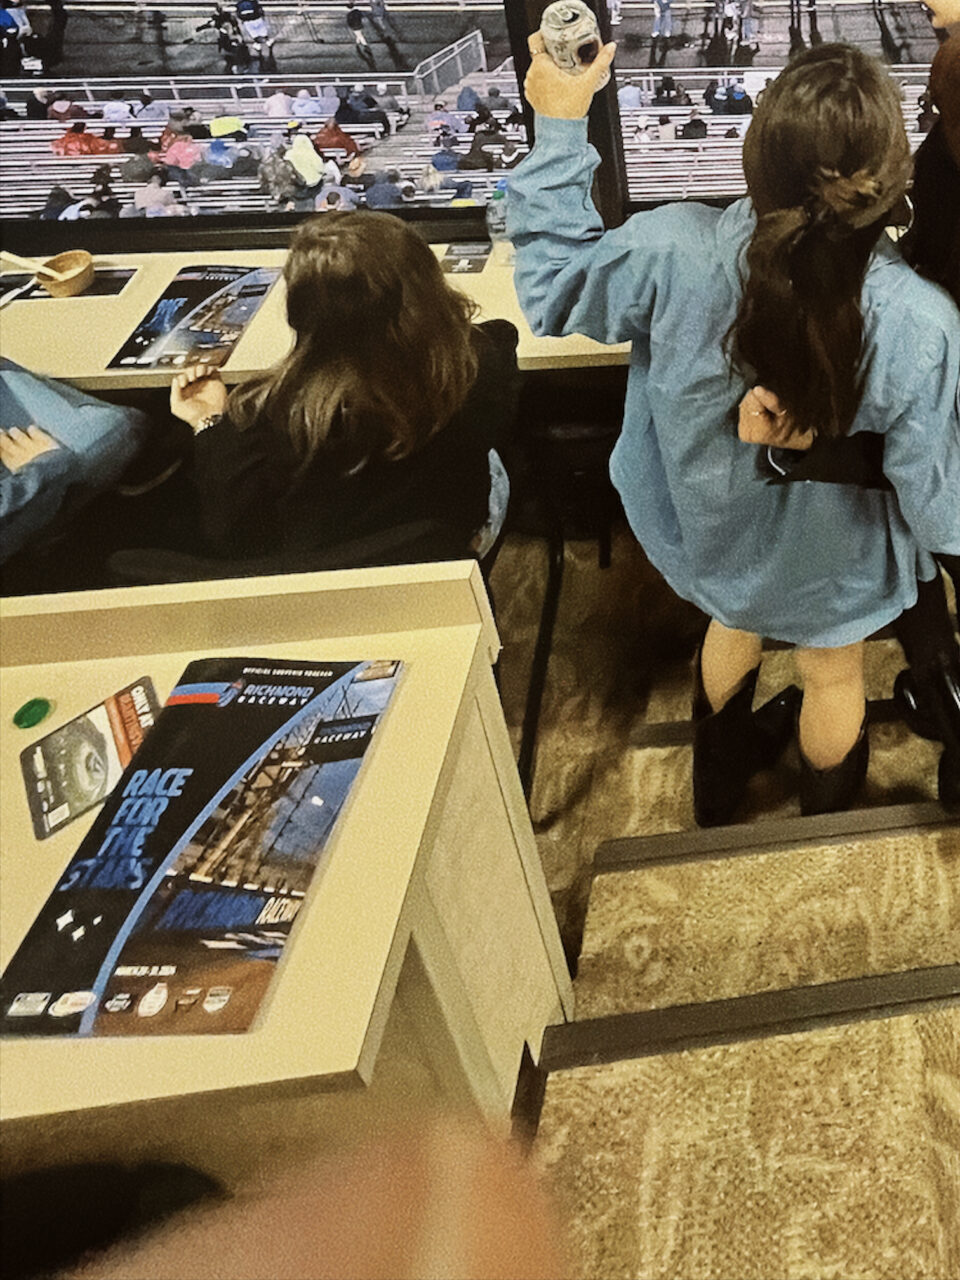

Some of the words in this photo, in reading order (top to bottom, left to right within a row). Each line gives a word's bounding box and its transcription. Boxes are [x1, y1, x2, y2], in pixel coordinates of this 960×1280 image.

[243, 685, 315, 698] RICHMOND
[122, 767, 194, 798] RACE
[111, 796, 170, 827] FOR
[97, 825, 155, 857] THE
